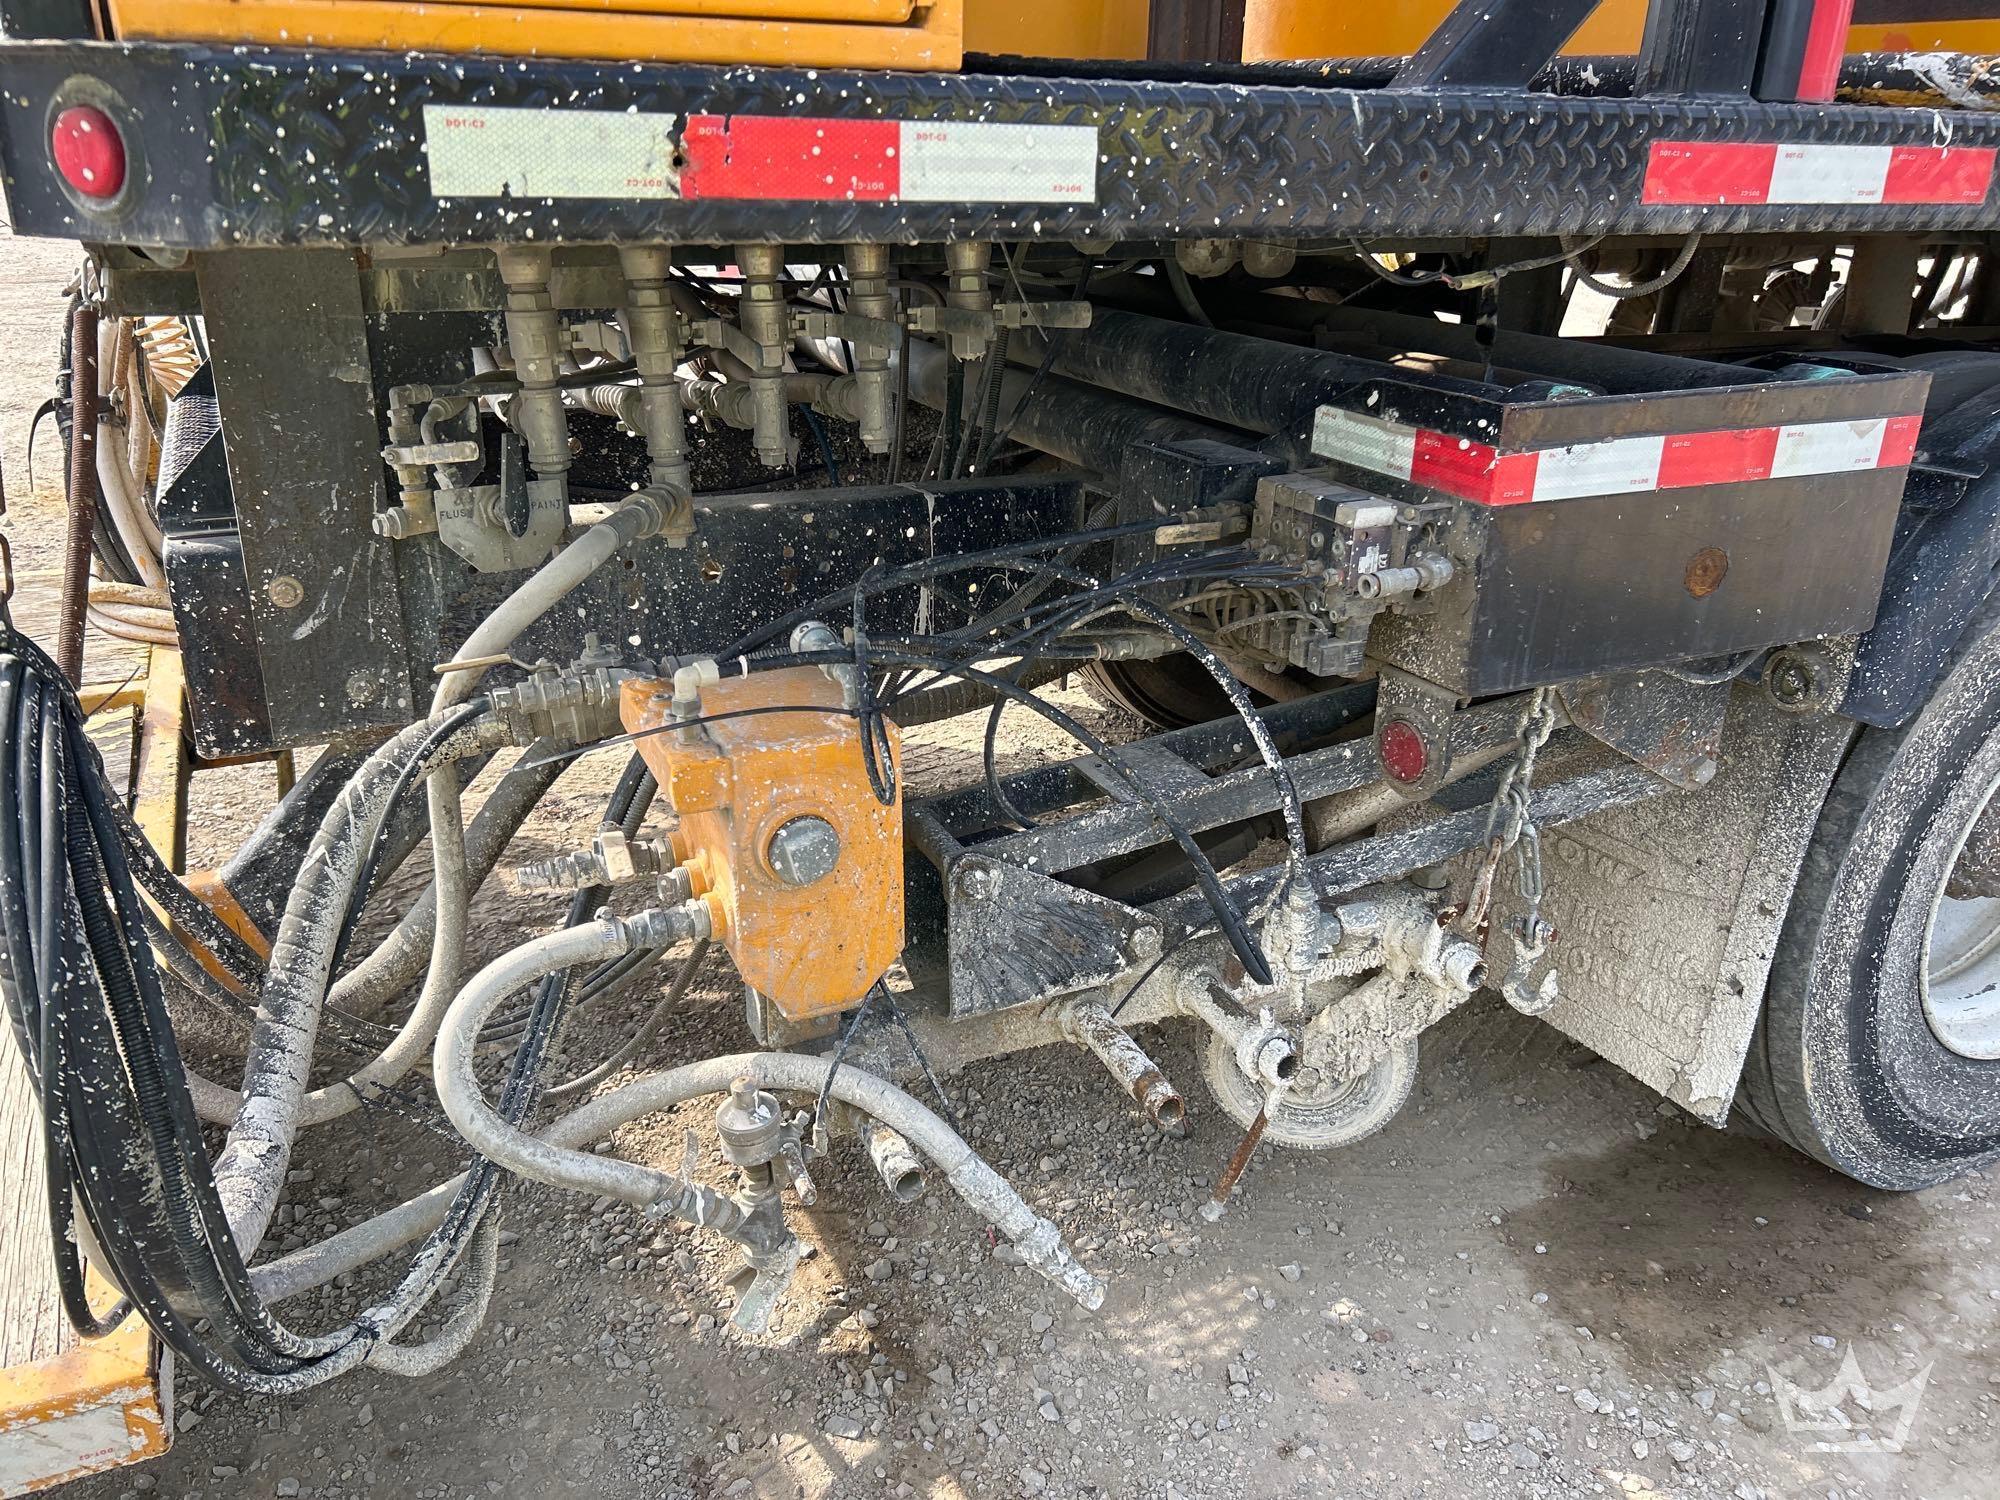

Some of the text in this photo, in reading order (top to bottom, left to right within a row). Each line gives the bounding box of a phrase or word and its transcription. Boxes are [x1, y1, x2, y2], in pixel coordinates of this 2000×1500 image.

[446, 118, 485, 128] DOT-C2
[916, 132, 947, 142] DOT-C2
[627, 179, 662, 188] DOT-C2
[1053, 184, 1082, 192] DOT-C2
[531, 499, 562, 510] PAINT
[79, 1447, 115, 1461] DOT-C2
